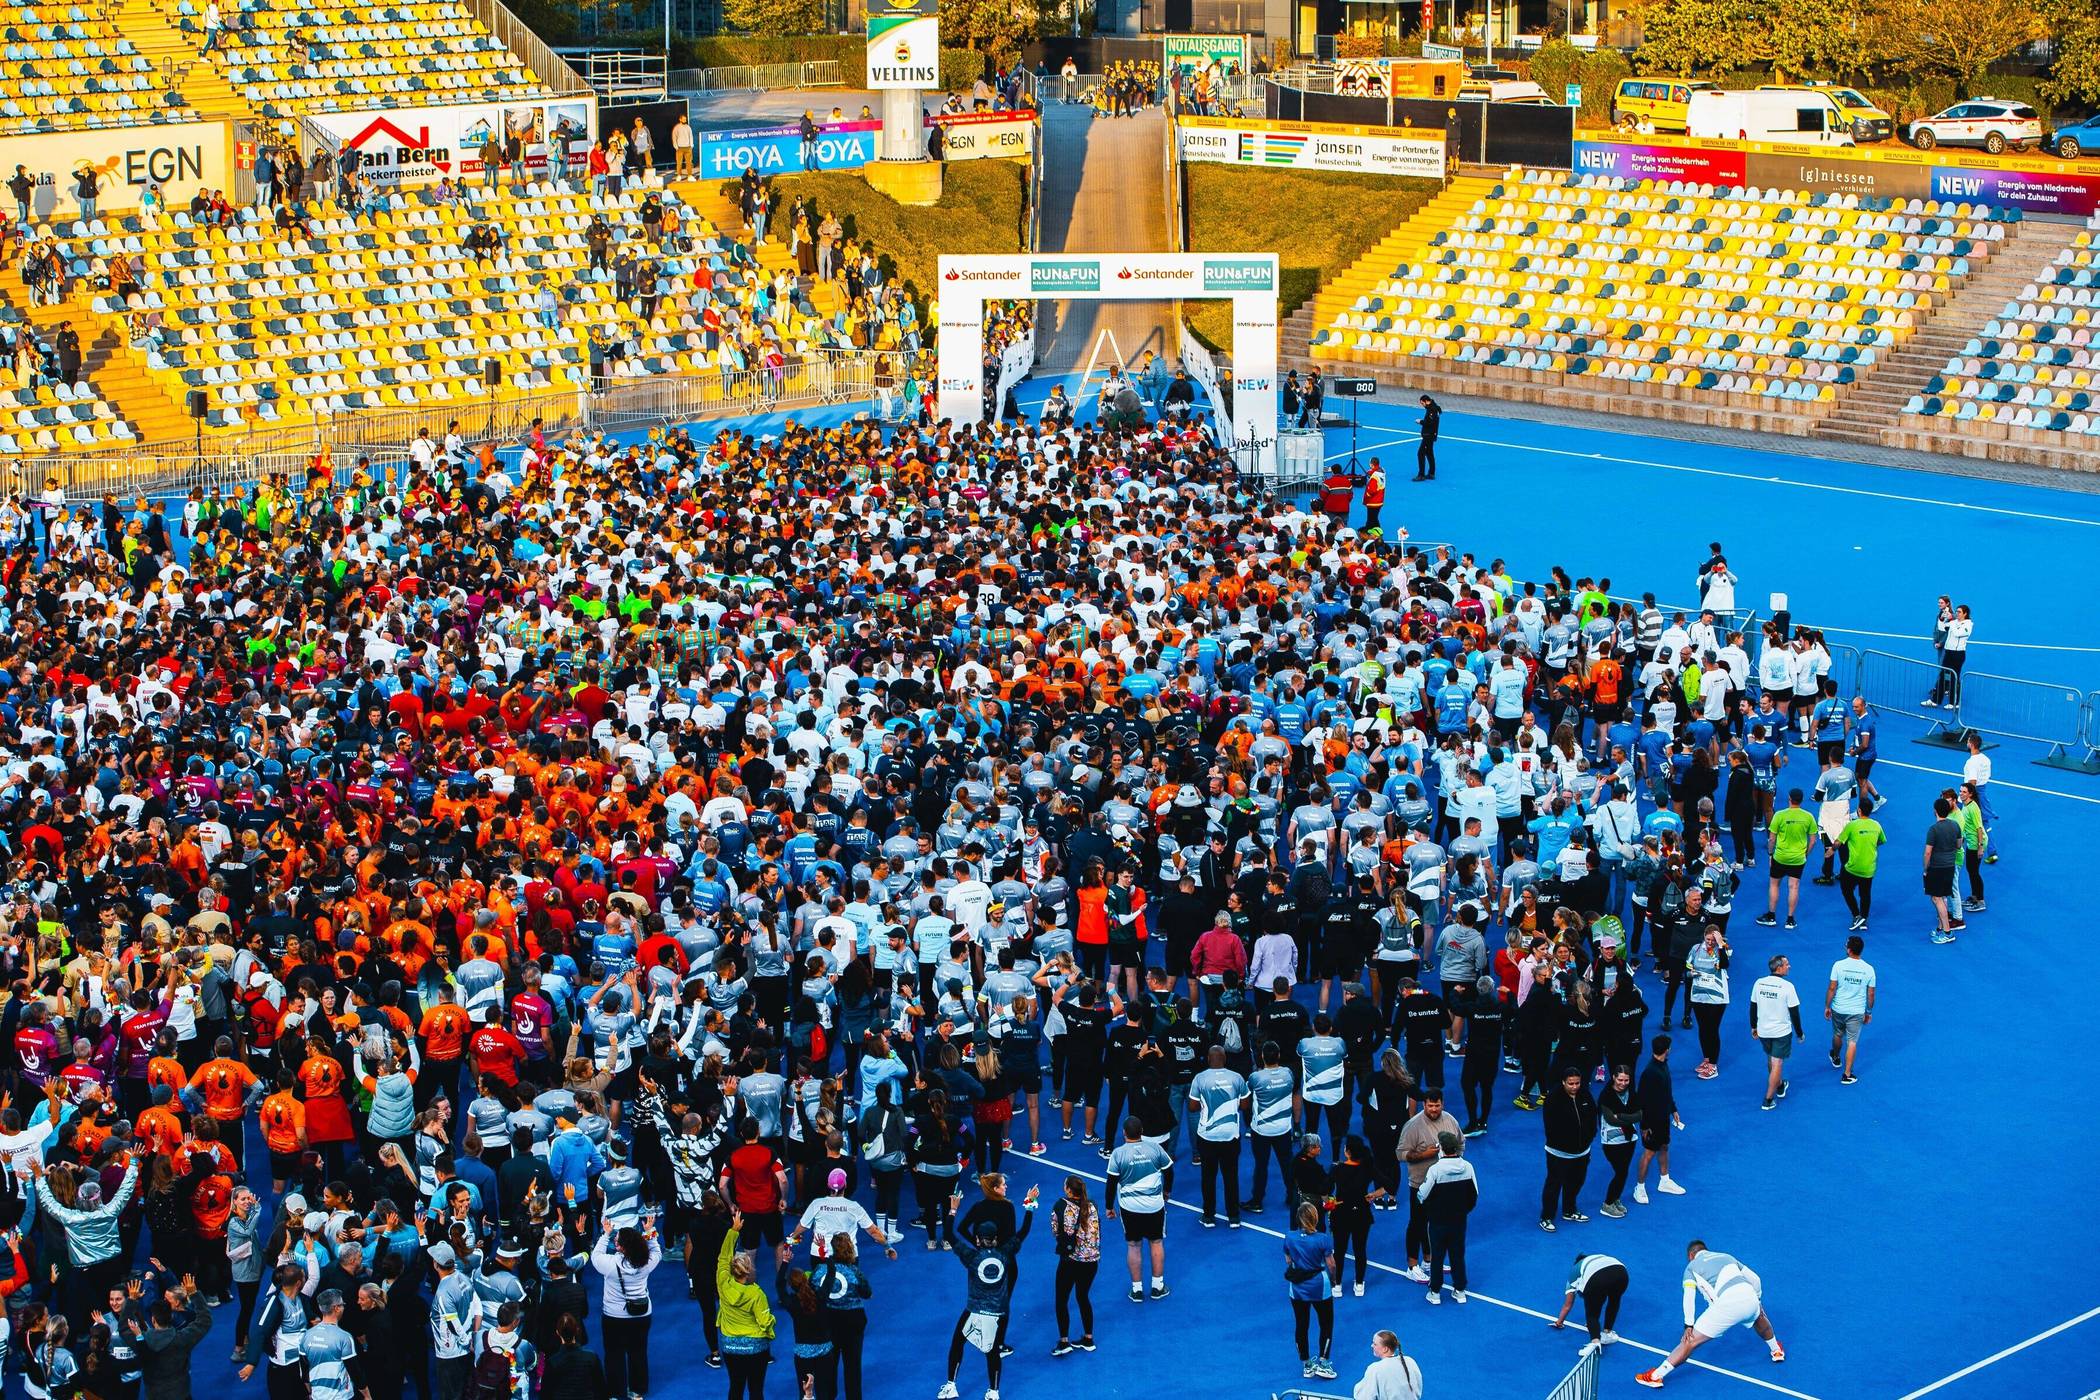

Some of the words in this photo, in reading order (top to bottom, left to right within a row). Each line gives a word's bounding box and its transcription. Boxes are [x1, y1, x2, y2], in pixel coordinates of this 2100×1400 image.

[1168, 38, 1240, 53] NOTAUSGANG
[872, 67, 935, 81] VELTINS
[952, 135, 975, 149] EGN
[1001, 132, 1024, 145] EGN
[397, 147, 449, 164] Bern
[1183, 149, 1226, 158] Haustechnik
[1403, 145, 1427, 154] Partner
[712, 144, 784, 171] HOYA
[1315, 157, 1362, 167] Haustechnik
[1372, 153, 1398, 163] Energie
[1632, 153, 1656, 164] Energie
[1672, 156, 1709, 166] Niederrhein
[126, 145, 202, 185] EGN
[1632, 163, 1641, 171] für
[1643, 164, 1657, 172] dein
[1658, 165, 1685, 174] Zuhause
[1800, 166, 1875, 185] [g]niessen
[1998, 180, 2026, 191] Energie
[2027, 183, 2043, 191] vom
[2044, 183, 2087, 194] Niederrhein
[1998, 190, 2008, 199] für
[2010, 191, 2026, 200] dein
[2027, 193, 2058, 202] Zuhause
[961, 269, 1022, 281] Santander
[1033, 268, 1098, 280] RUN&FUN
[1134, 268, 1194, 280] Santander
[1205, 267, 1271, 279] RUN&FUN
[1356, 382, 1374, 392] 0:00
[979, 593, 995, 606] 38
[1418, 1008, 1440, 1016] united.
[820, 1205, 848, 1213] #TeamEli
